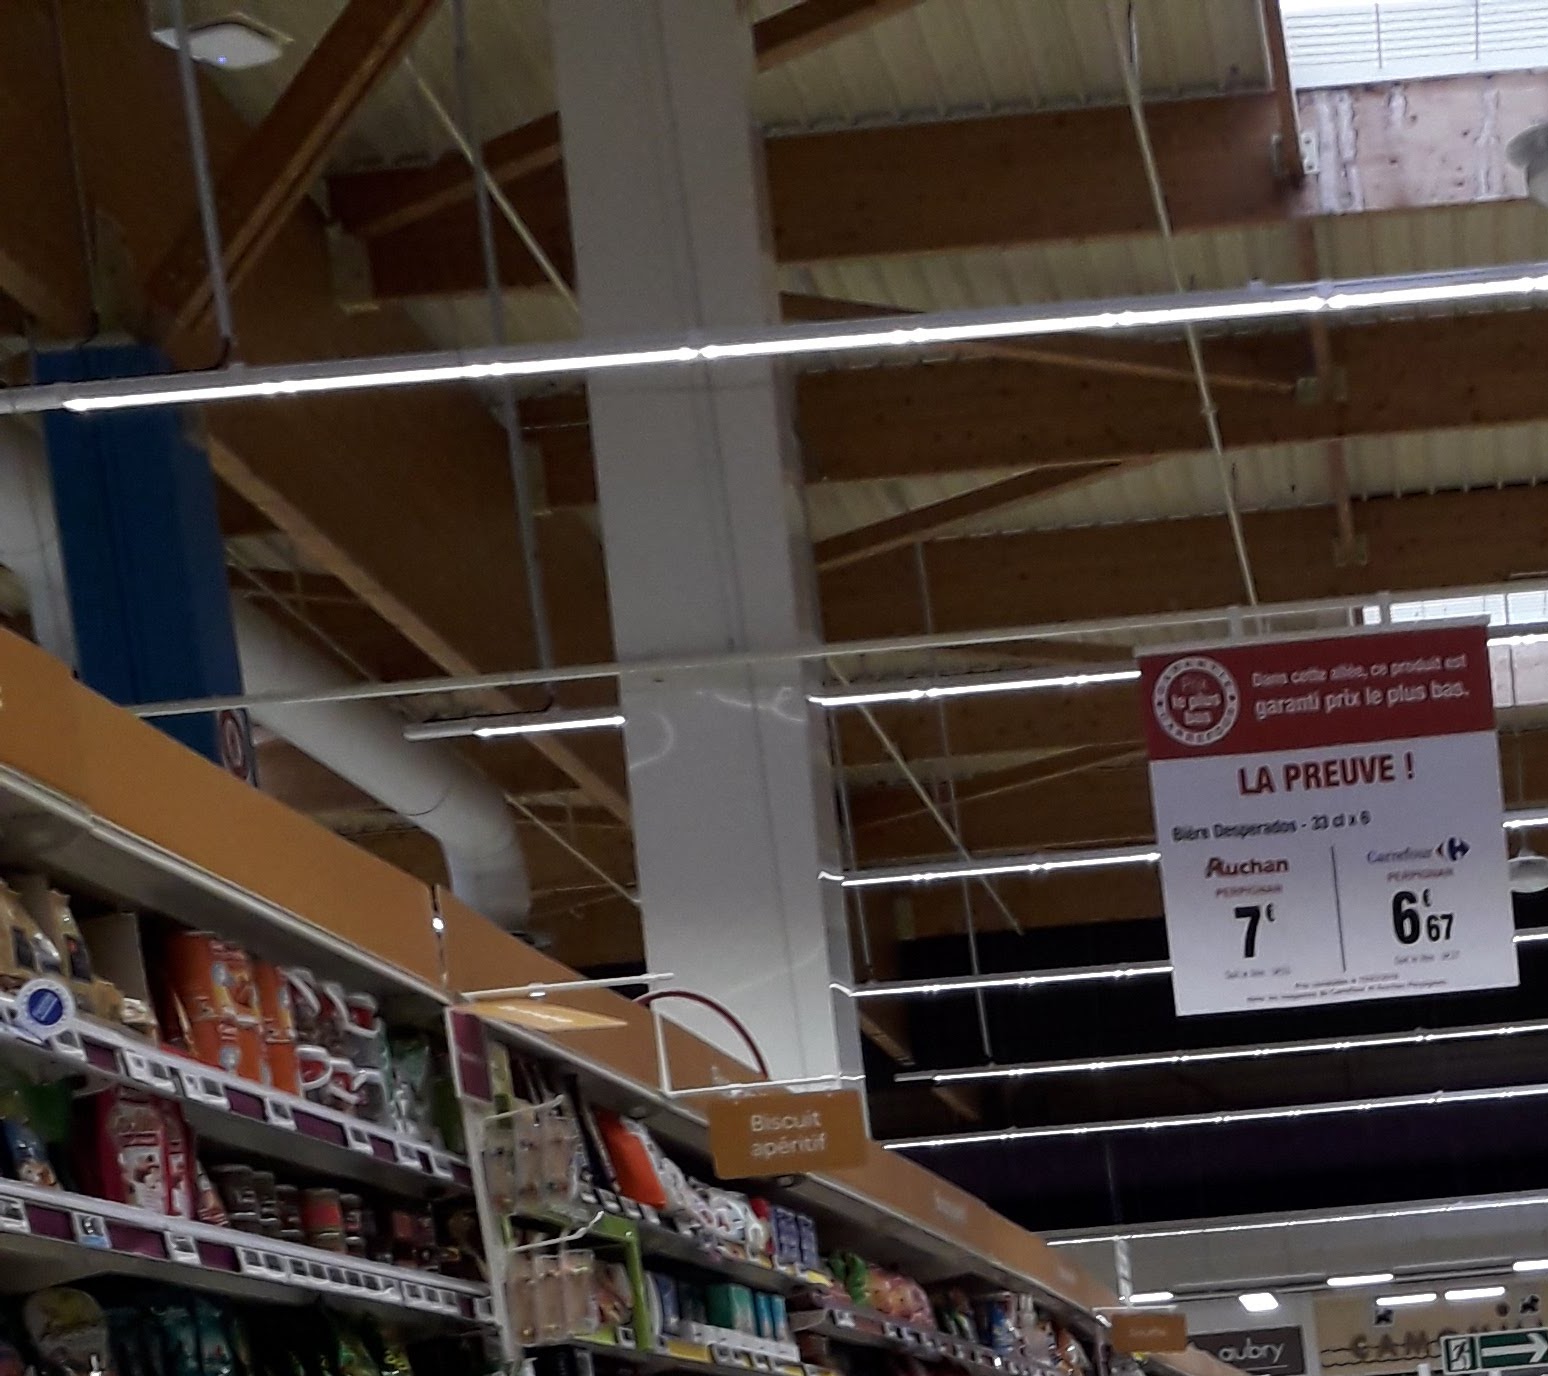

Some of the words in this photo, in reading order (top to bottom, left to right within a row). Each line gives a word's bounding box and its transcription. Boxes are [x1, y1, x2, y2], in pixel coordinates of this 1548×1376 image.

[1256, 690, 1320, 720] garanti
[1325, 688, 1360, 713] prix
[1366, 687, 1383, 706] le
[1387, 684, 1426, 707] plus
[1238, 764, 1275, 796] LA
[1283, 754, 1396, 793] PREUVE
[1213, 819, 1298, 840] Desperados
[1205, 857, 1290, 879] Auchan
[751, 1110, 823, 1132] Biscuit
[752, 1132, 826, 1160] apéritif
[1219, 1337, 1285, 1364] aubry
